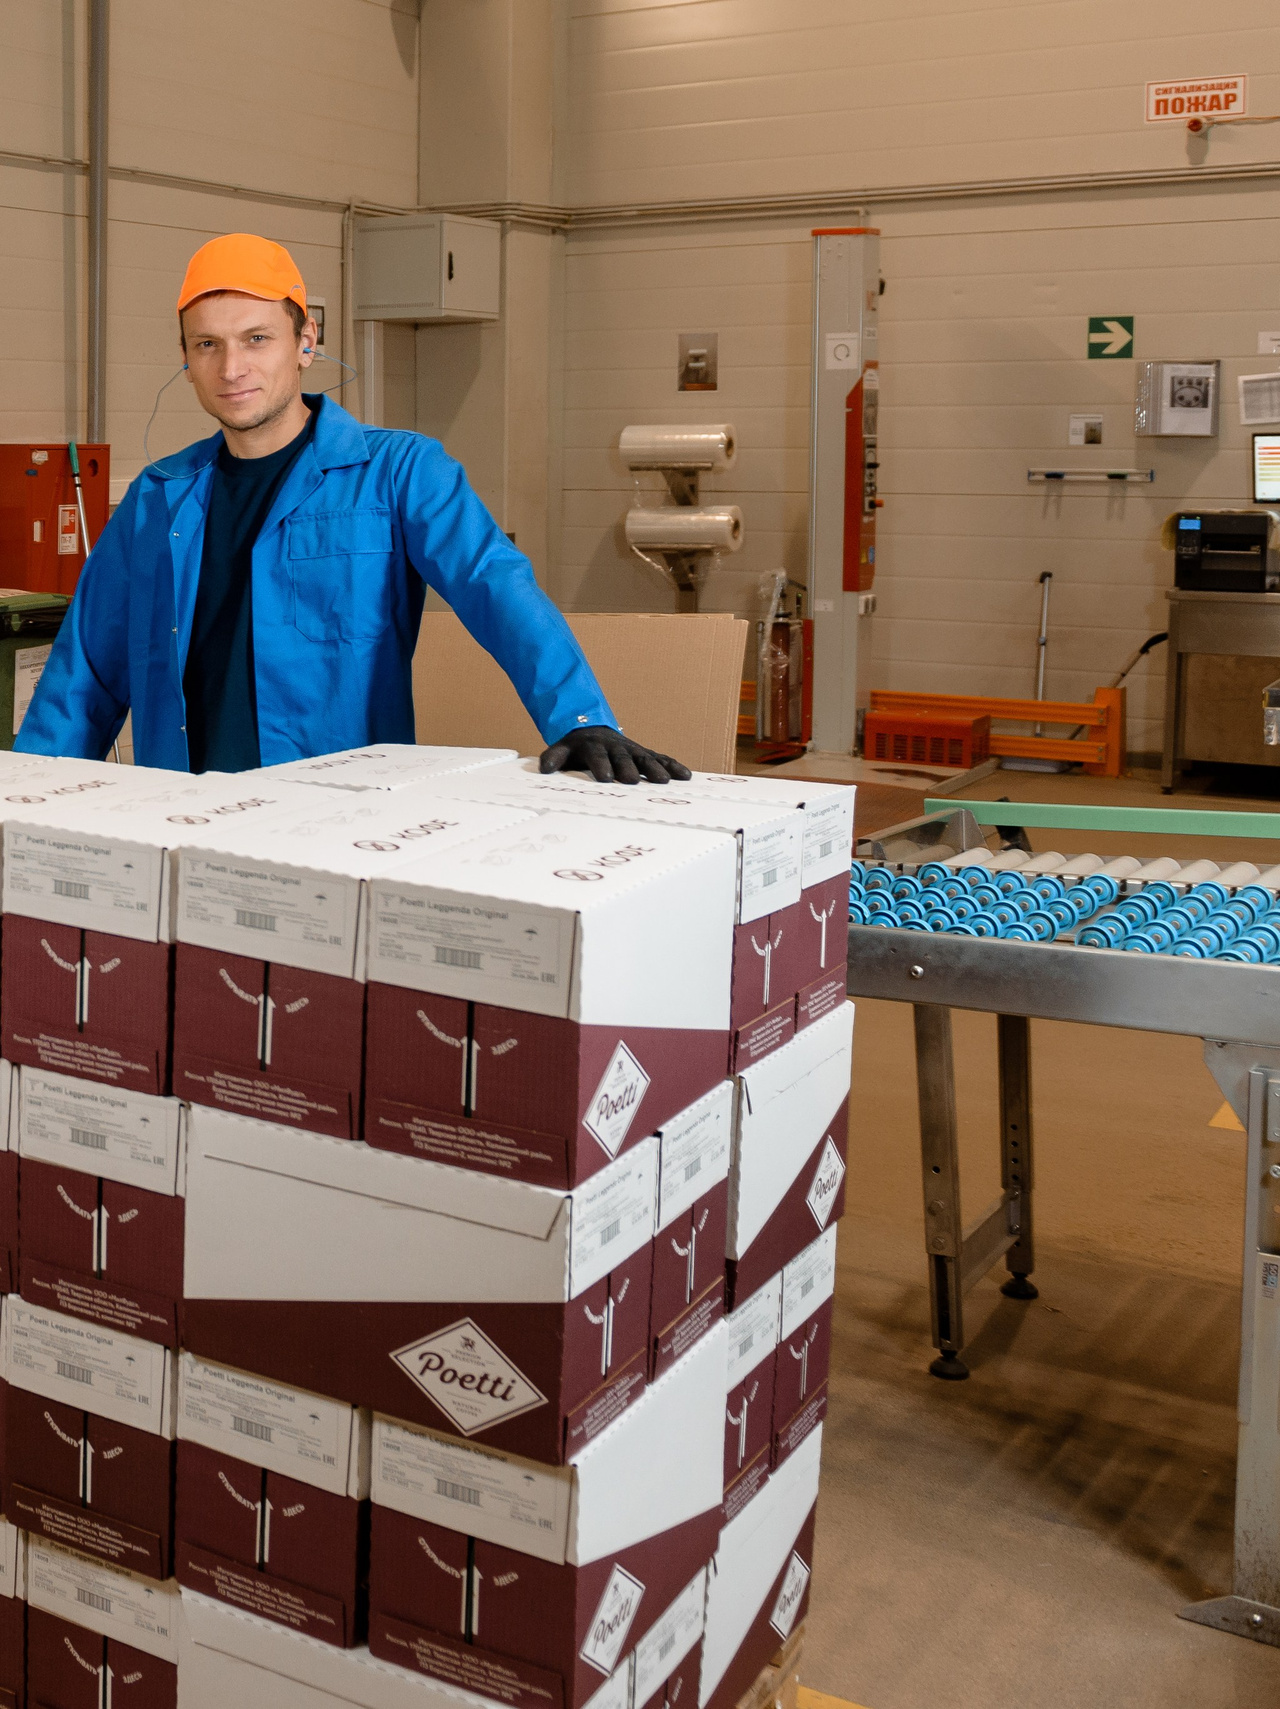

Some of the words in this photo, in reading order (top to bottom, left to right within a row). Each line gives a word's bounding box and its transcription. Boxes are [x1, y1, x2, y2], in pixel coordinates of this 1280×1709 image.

[1154, 80, 1238, 96] СИГНАЛИЗАЦИЯ
[1154, 92, 1237, 116] ПОЖАР
[44, 779, 119, 796] КОФЕ
[204, 797, 279, 816] КОФЕ
[394, 818, 461, 841] КОФЕ
[26, 836, 46, 845] Poetti
[48, 840, 82, 851] Leggenda
[84, 844, 112, 856] Original
[599, 843, 657, 869] КОФЕ
[206, 862, 228, 873] Poetti
[230, 867, 268, 880] Leggenda
[270, 873, 302, 886] Original
[399, 896, 426, 909] Poetti
[428, 899, 471, 916] Leggenda
[473, 906, 509, 920] Original
[42, 1083, 64, 1094] Poetti
[64, 1088, 99, 1102] Leggenda
[100, 1096, 128, 1109] Original
[596, 1076, 640, 1128] Poetti
[813, 1164, 840, 1204] Poetti
[30, 1315, 49, 1328] Poetti
[50, 1320, 84, 1338] Leggenda
[86, 1331, 114, 1346] Original
[202, 1366, 225, 1380] Poetti
[226, 1373, 264, 1392] Leggenda
[265, 1386, 296, 1403] Original
[418, 1352, 517, 1402] Poetti
[43, 1410, 78, 1448] ОТКРЫВАТЬ
[102, 1446, 124, 1460] ЗДЕСЬ
[218, 1470, 256, 1511] ОТКРЫВАТЬ
[282, 1503, 306, 1518] ЗДЕСЬ
[78, 1516, 91, 1527] ООО
[50, 1542, 70, 1555] Poetti
[70, 1548, 104, 1567] Leggenda
[104, 1562, 132, 1578] Original
[418, 1536, 461, 1579] ОТКРЫВАТЬ
[492, 1571, 519, 1588] ЗДЕСЬ
[592, 1589, 634, 1654] Poetti
[63, 1636, 98, 1676] ОТКРЫВАТЬ
[122, 1671, 142, 1684] ЗДЕСЬ
